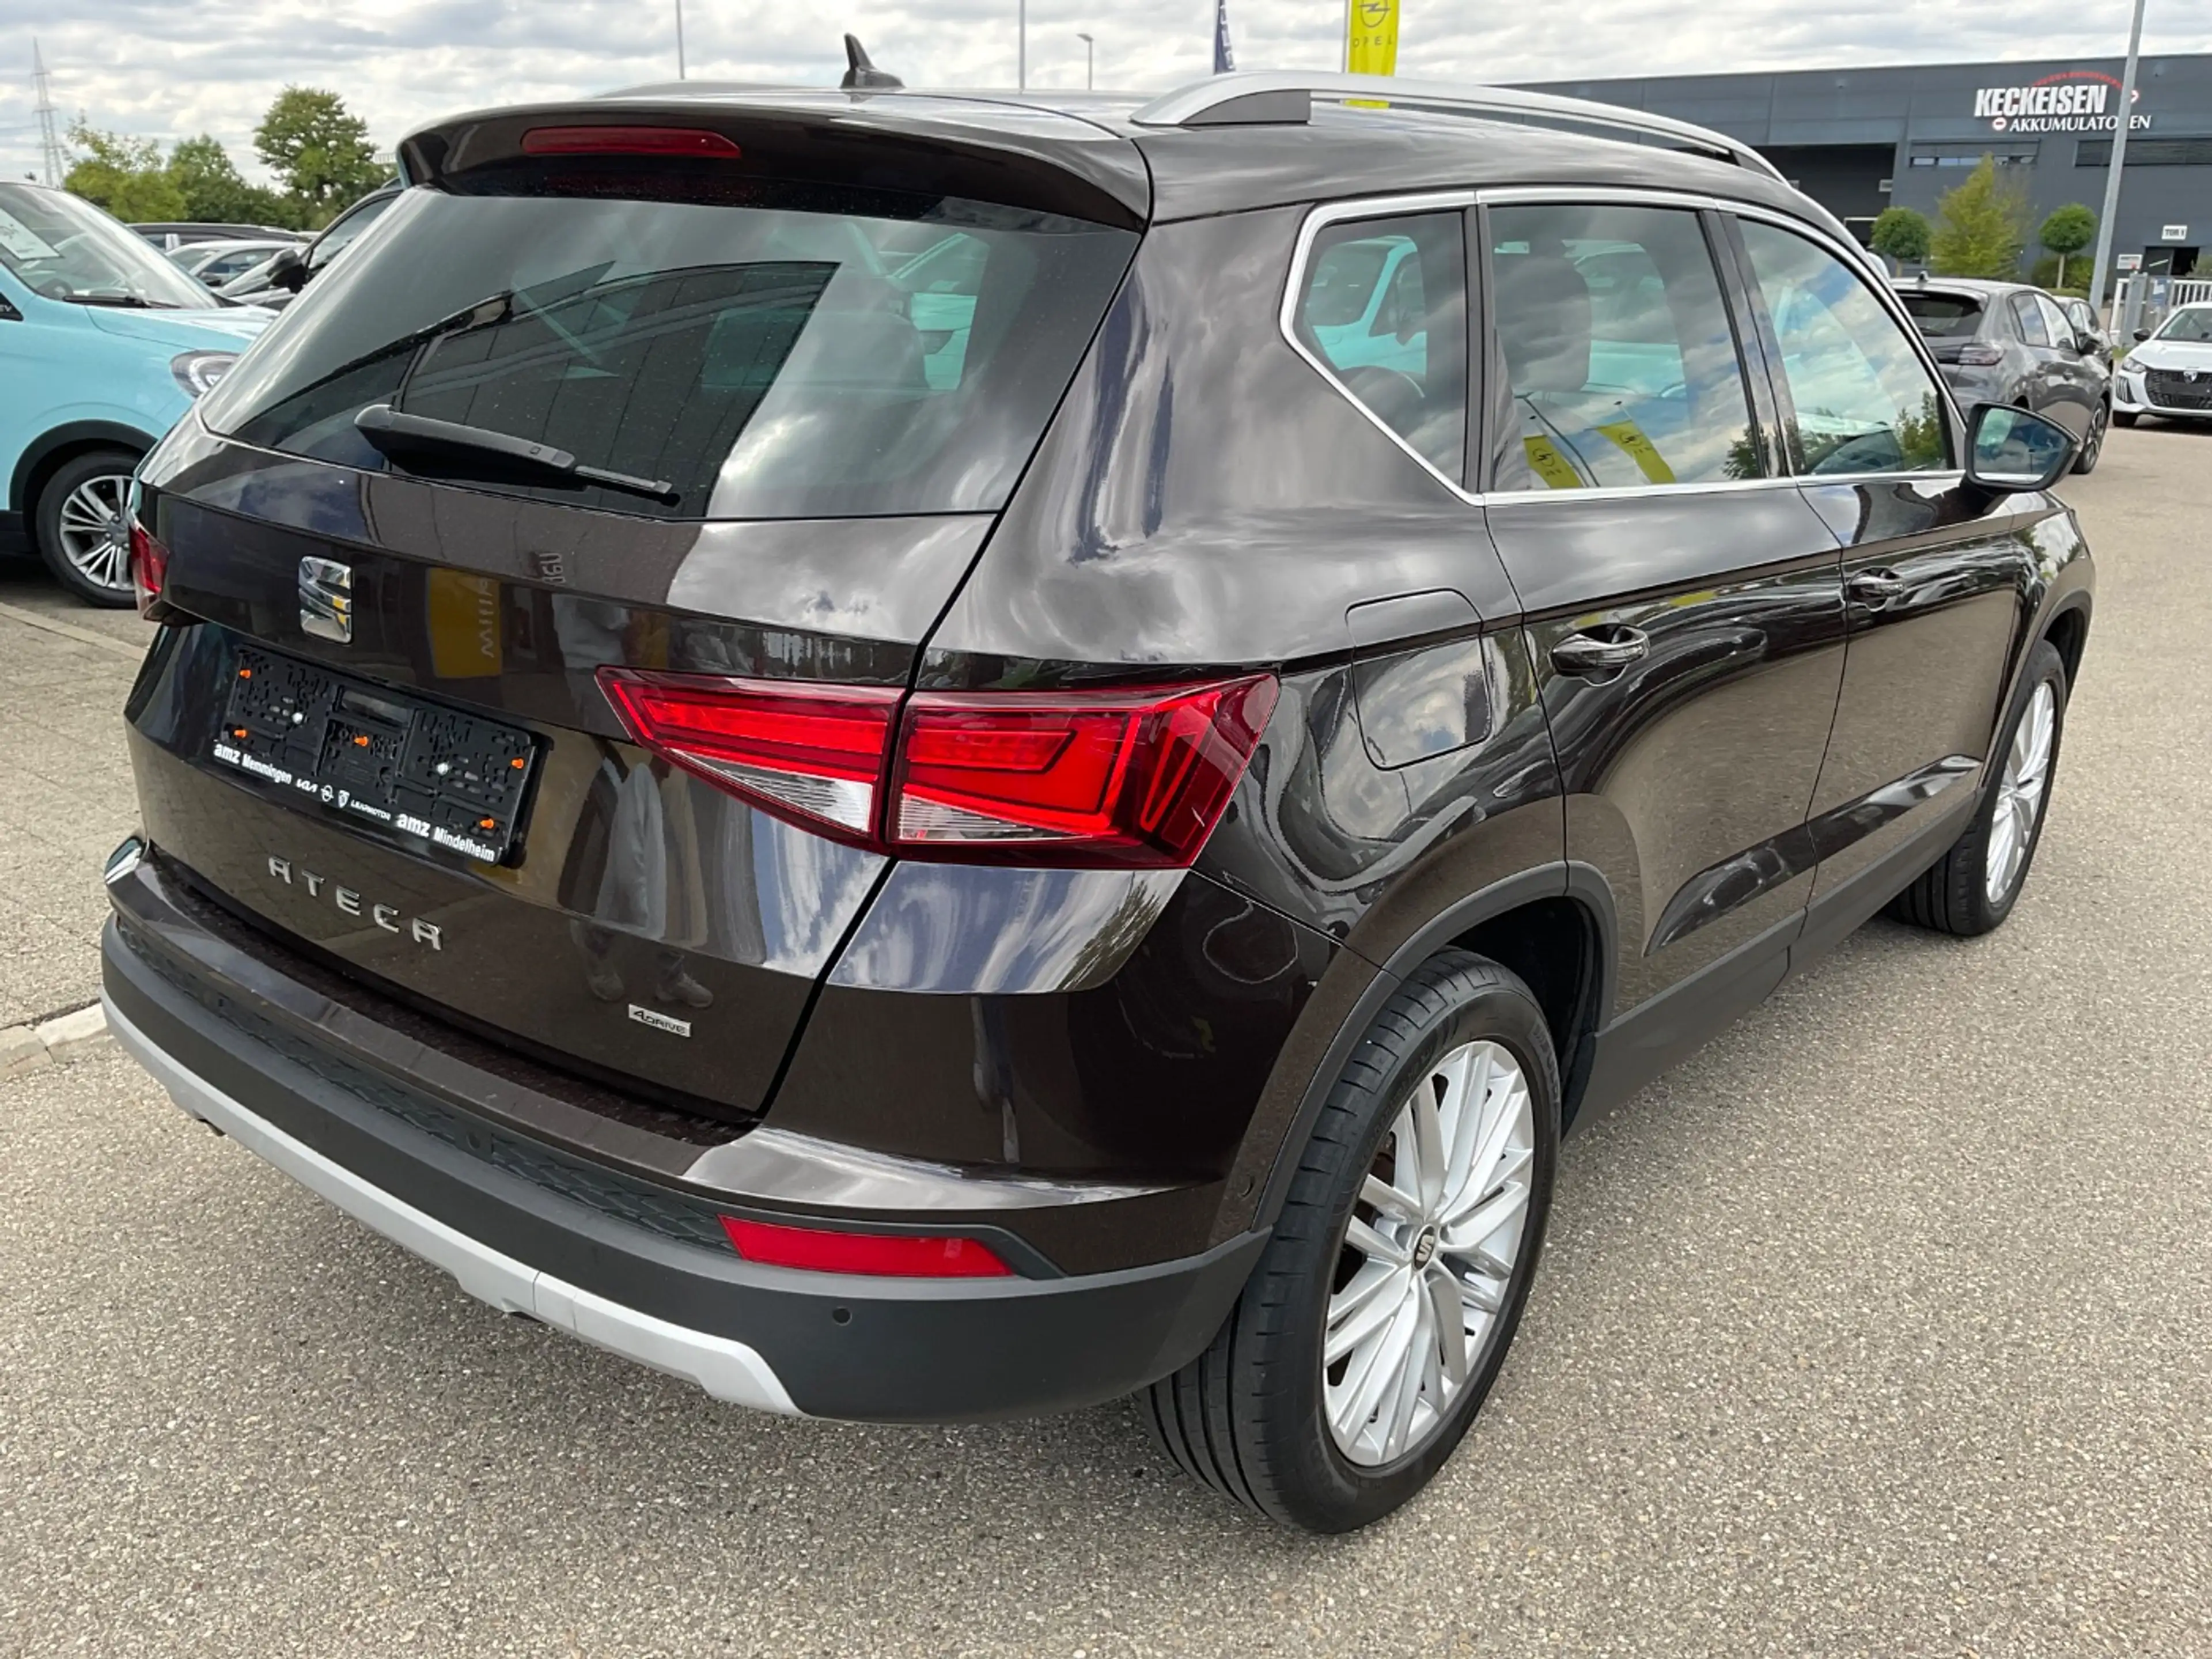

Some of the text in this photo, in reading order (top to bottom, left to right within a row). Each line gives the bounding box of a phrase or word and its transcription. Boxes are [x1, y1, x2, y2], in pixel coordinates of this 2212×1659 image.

[1352, 34, 1393, 49] OPEL
[1974, 85, 2108, 117] KECKEISEN
[2009, 115, 2152, 132] AKKUMULATOEN
[214, 744, 241, 764] amz
[396, 813, 495, 862] amz Mindelheim
[268, 855, 444, 950] ATECA
